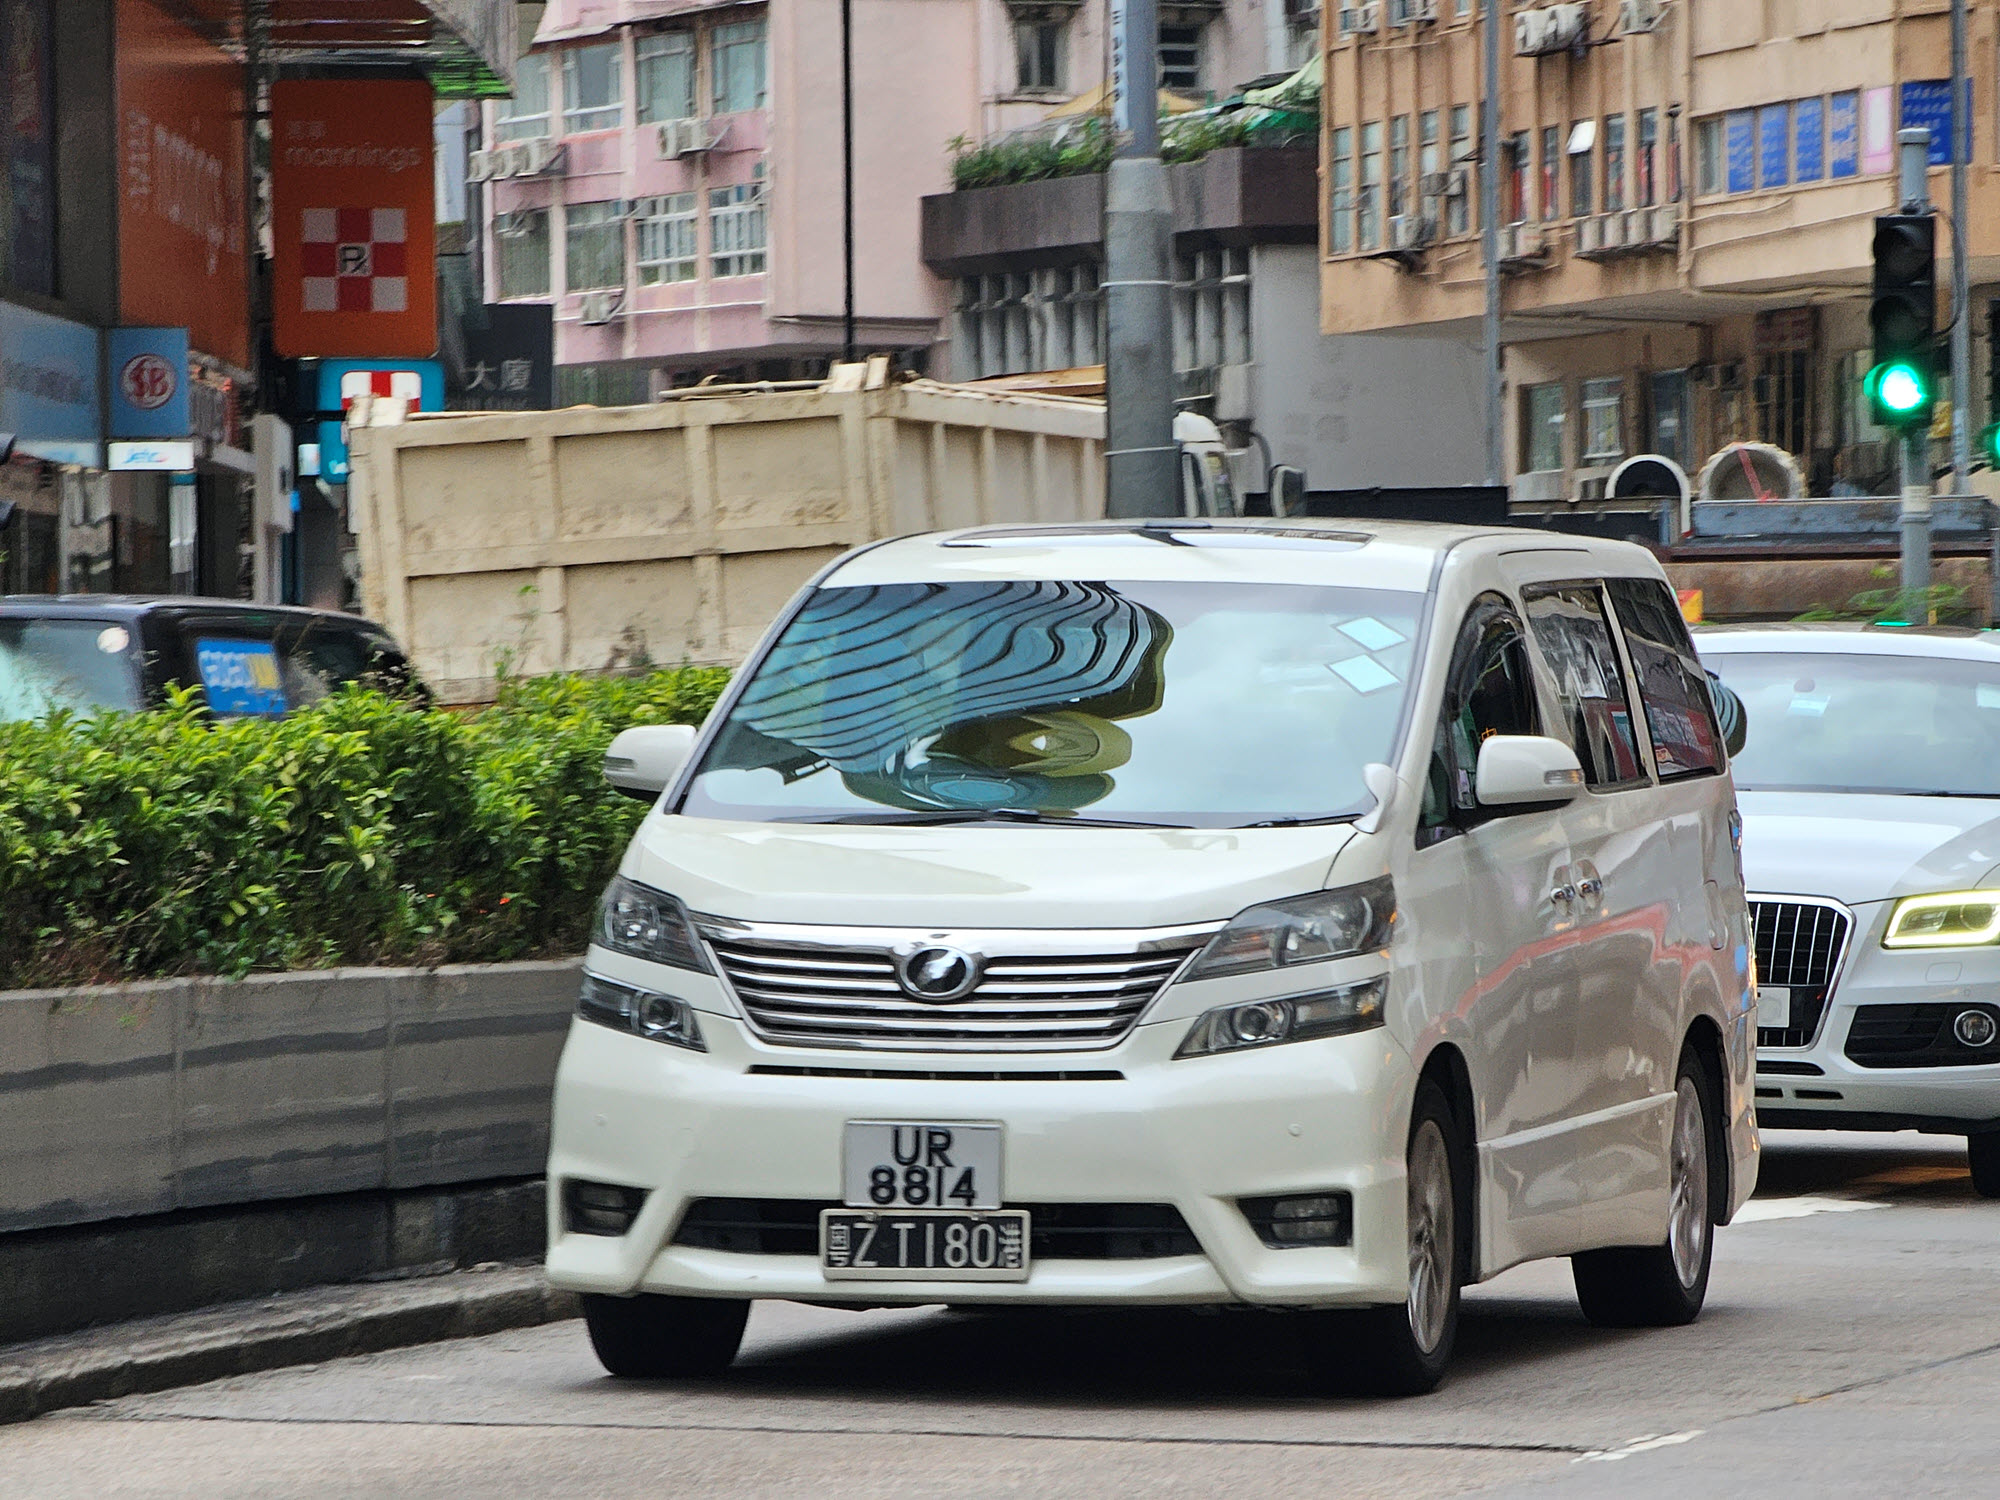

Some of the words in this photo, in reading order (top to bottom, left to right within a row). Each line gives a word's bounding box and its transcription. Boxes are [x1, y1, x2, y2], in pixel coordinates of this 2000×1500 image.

[285, 142, 423, 173] mannings
[893, 1126, 954, 1167] UR
[869, 1165, 976, 1207] 8814
